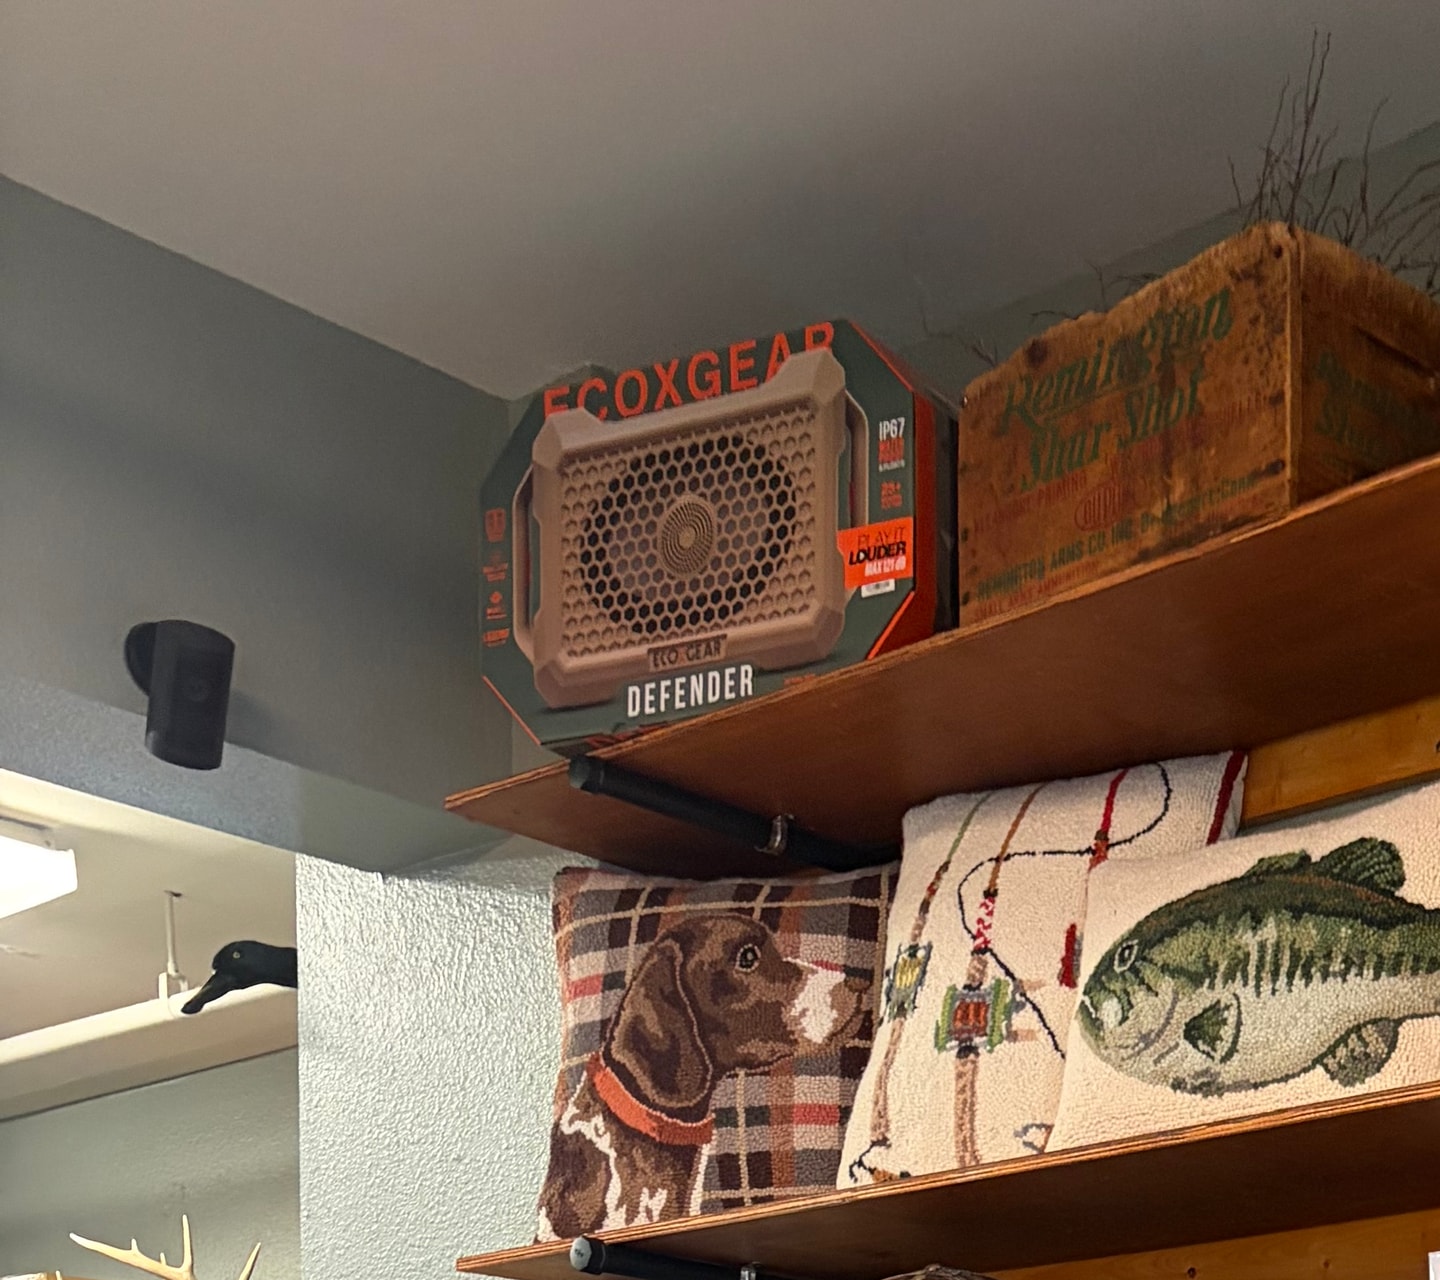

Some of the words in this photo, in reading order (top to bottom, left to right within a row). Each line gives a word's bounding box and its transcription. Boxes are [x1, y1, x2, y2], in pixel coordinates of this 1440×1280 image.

[879, 417, 905, 441] IP67
[849, 541, 906, 565] LOUDER
[627, 665, 753, 717] DEFENDER
